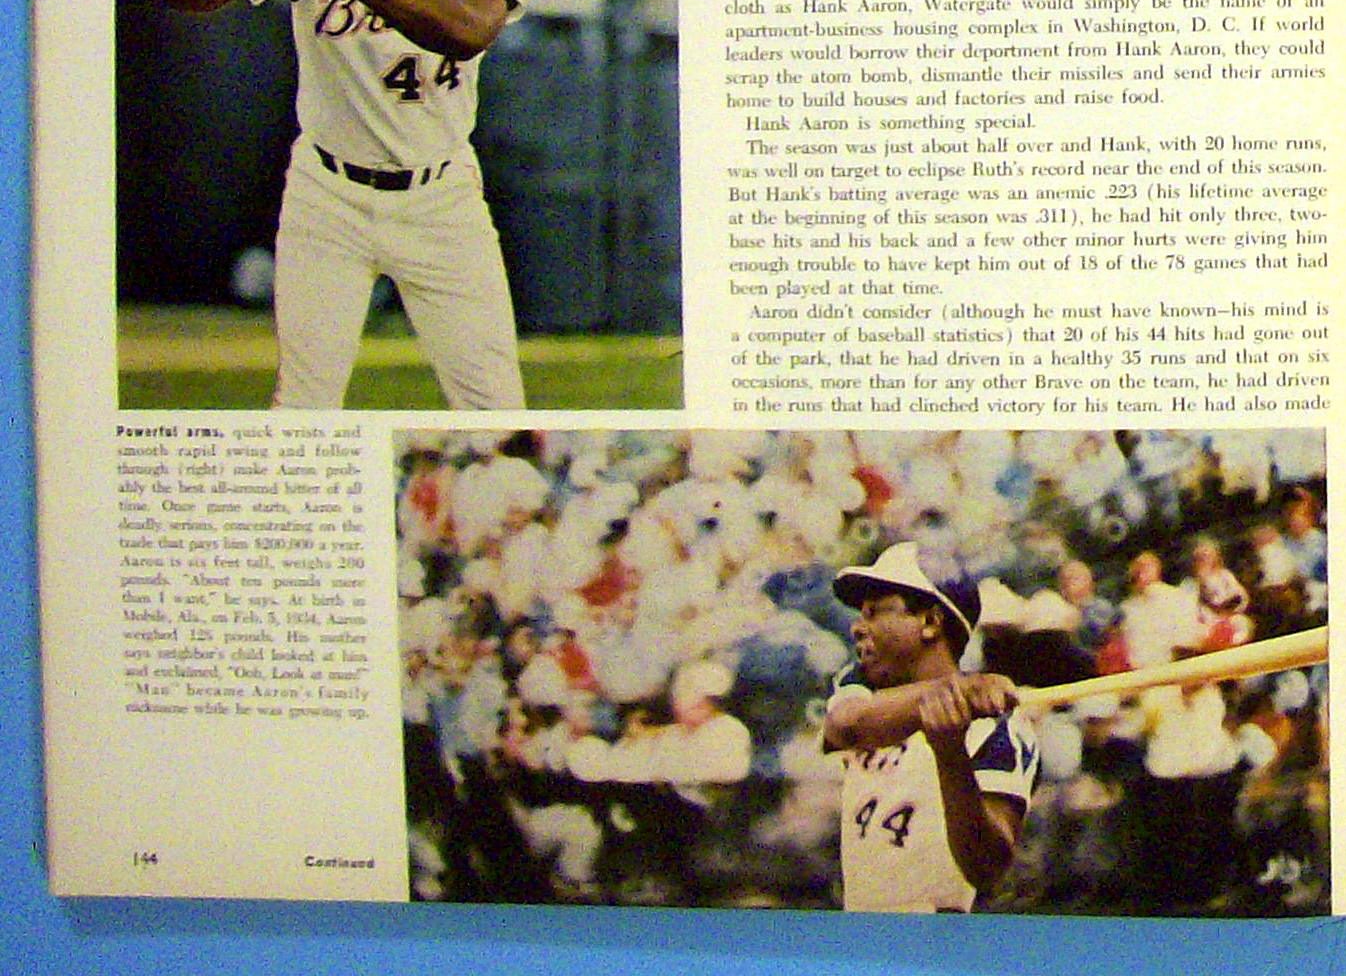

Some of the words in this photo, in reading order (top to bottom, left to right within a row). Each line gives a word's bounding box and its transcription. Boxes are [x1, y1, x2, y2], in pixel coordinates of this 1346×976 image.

[724, 21, 884, 42] apartment-business
[893, 19, 959, 40] housing
[967, 18, 1039, 39] complex
[1047, 19, 1064, 34] in
[1251, 16, 1266, 32] If
[1275, 16, 1325, 31] world
[383, 53, 462, 104] 44
[745, 116, 791, 131] Hank
[798, 116, 849, 130] Aaron
[857, 116, 872, 130] is
[879, 114, 966, 134] something
[728, 187, 758, 202] But
[765, 185, 822, 202] Hank's
[828, 186, 888, 205] batting
[894, 189, 960, 205] average
[967, 190, 1000, 200] was
[1007, 190, 1029, 200] an
[1035, 186, 1096, 200] anemic
[1189, 182, 1254, 199] lifetime
[1261, 186, 1328, 201] average
[732, 402, 749, 411] in
[755, 396, 782, 412] the
[787, 402, 824, 412] runs
[830, 397, 863, 412] that
[870, 396, 902, 412] had
[908, 396, 980, 412] clinched
[986, 399, 1046, 416] victory
[1052, 397, 1078, 413] for
[1084, 397, 1109, 413] his
[1171, 396, 1197, 411] He
[1204, 395, 1236, 411] had
[1243, 395, 1278, 411] also
[1284, 394, 1331, 410] made
[115, 425, 179, 437] Powerful
[185, 428, 226, 438] arms,
[855, 796, 915, 848] 44
[133, 851, 159, 866] 144
[304, 855, 376, 869] Continued
